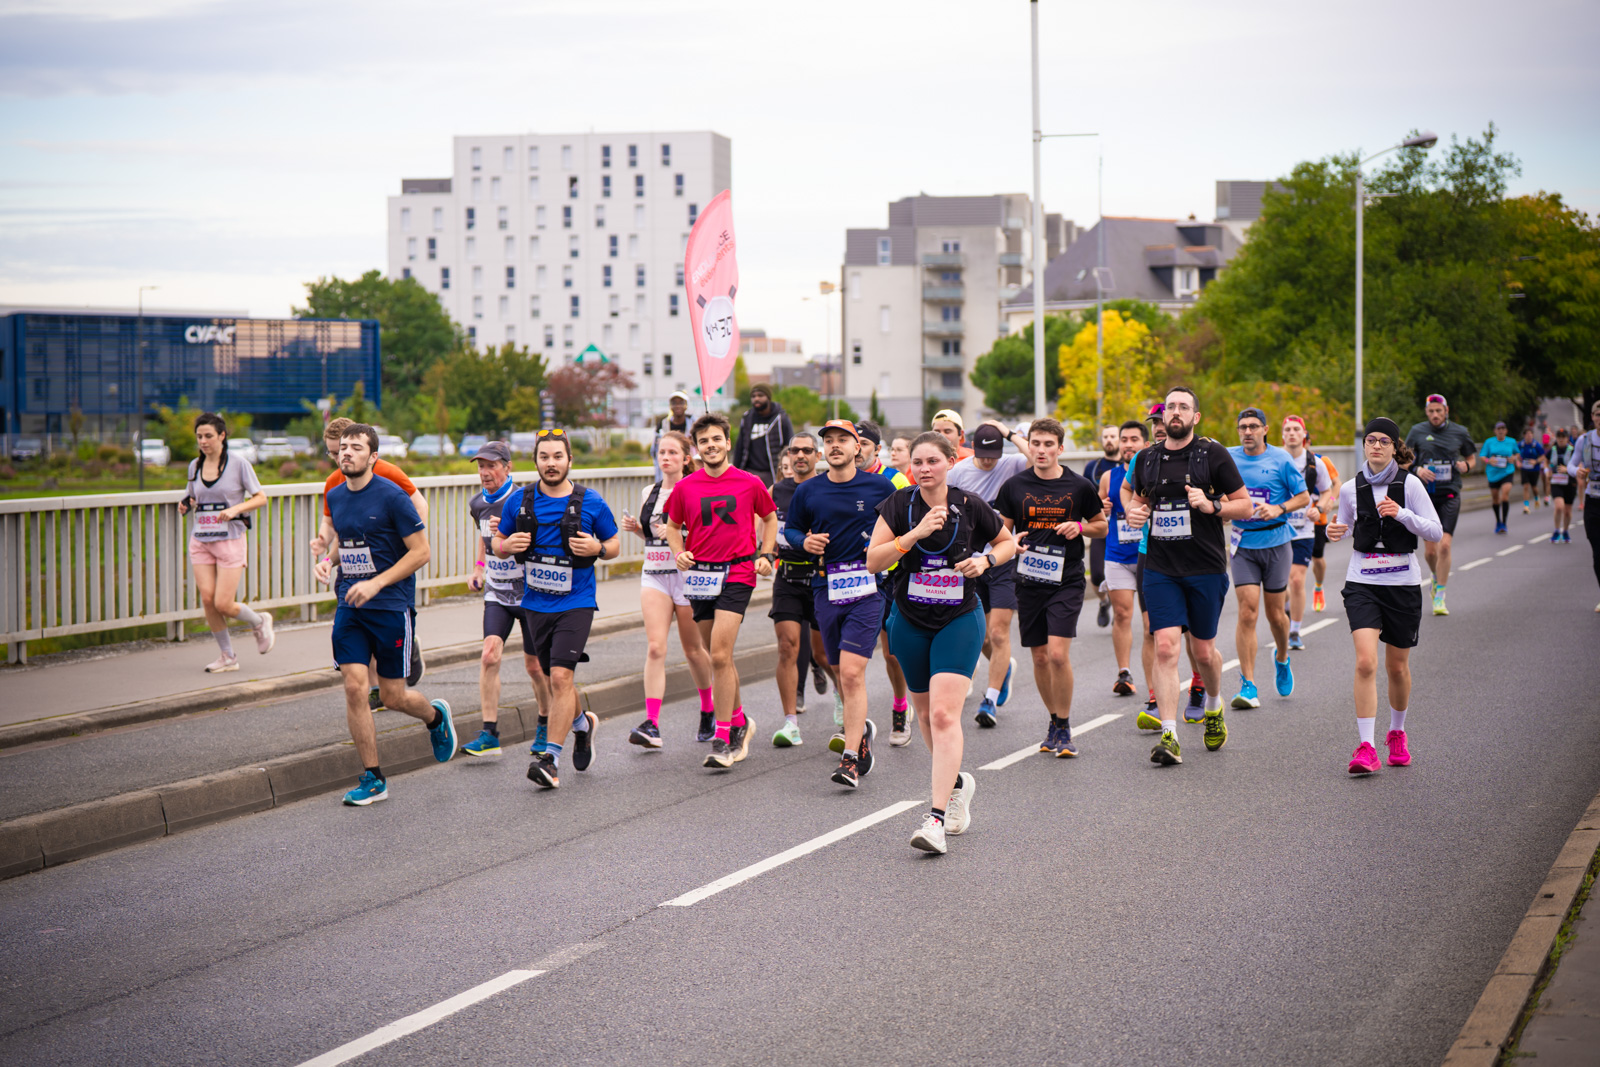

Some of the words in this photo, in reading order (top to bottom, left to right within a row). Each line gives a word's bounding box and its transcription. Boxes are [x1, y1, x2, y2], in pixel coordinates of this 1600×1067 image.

[700, 495, 738, 527] R
[1028, 521, 1061, 529] FINISH
[1155, 516, 1184, 527] 42851
[341, 553, 369, 565] 44242
[647, 551, 671, 562] 43367
[488, 560, 517, 571] 42492
[1022, 555, 1059, 572] 42969
[530, 567, 567, 582] 42906
[685, 575, 718, 586] 43934
[914, 572, 959, 588] 52299
[832, 575, 869, 590] 52271
